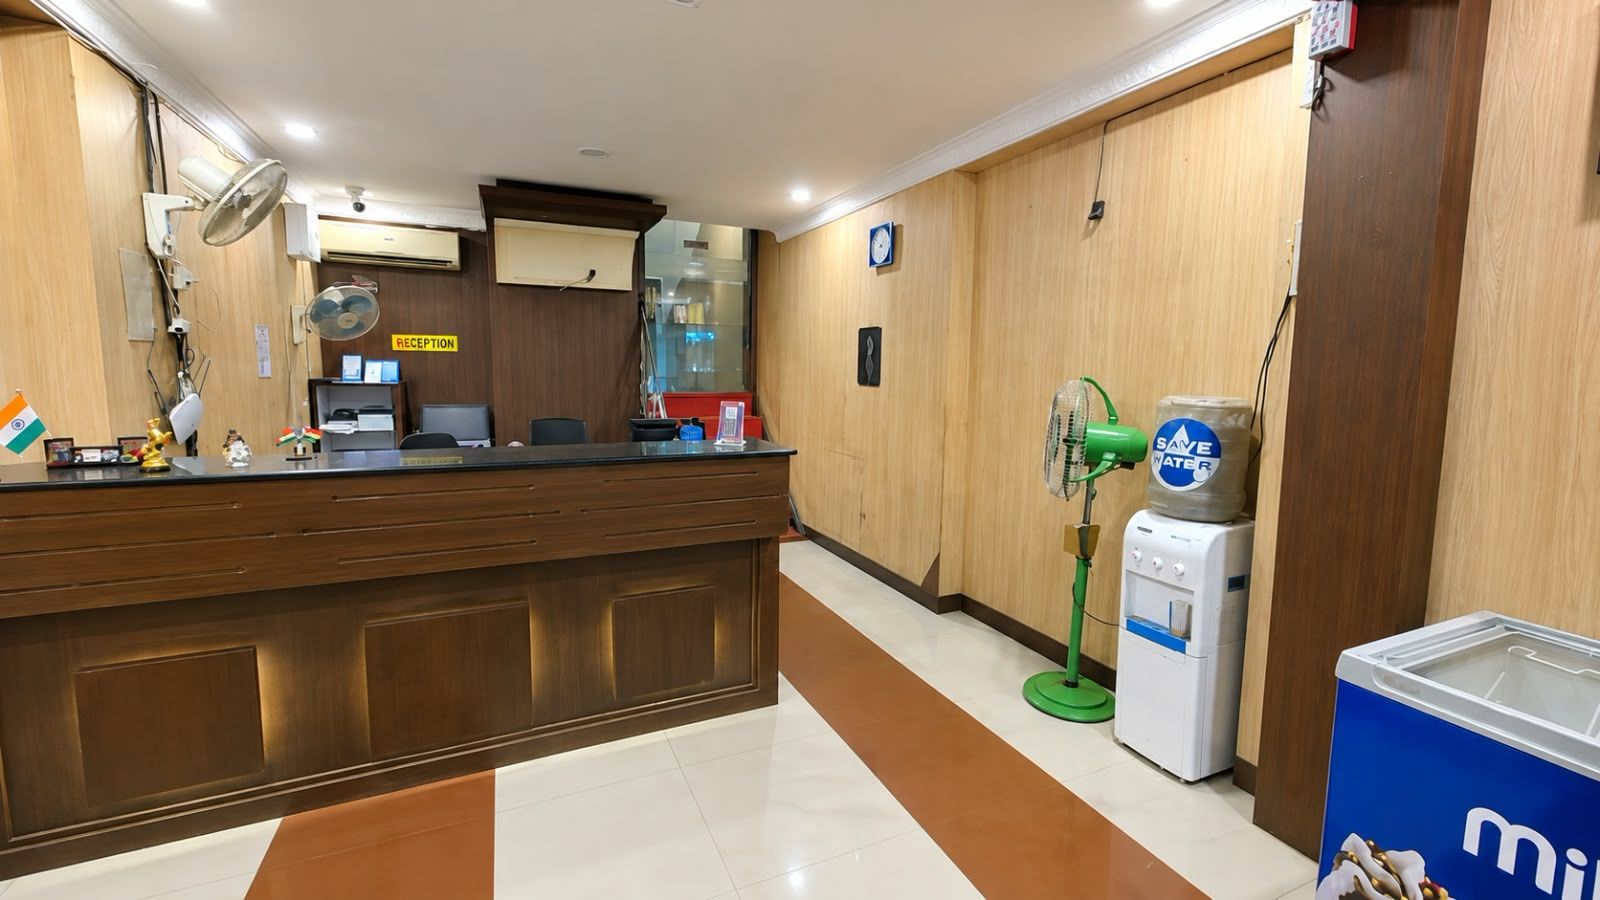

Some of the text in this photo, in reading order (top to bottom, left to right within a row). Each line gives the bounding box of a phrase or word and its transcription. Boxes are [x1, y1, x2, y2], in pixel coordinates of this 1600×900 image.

[396, 337, 455, 349] RECEPTION
[1156, 437, 1213, 455] SAVE
[1153, 455, 1212, 471] WATER
